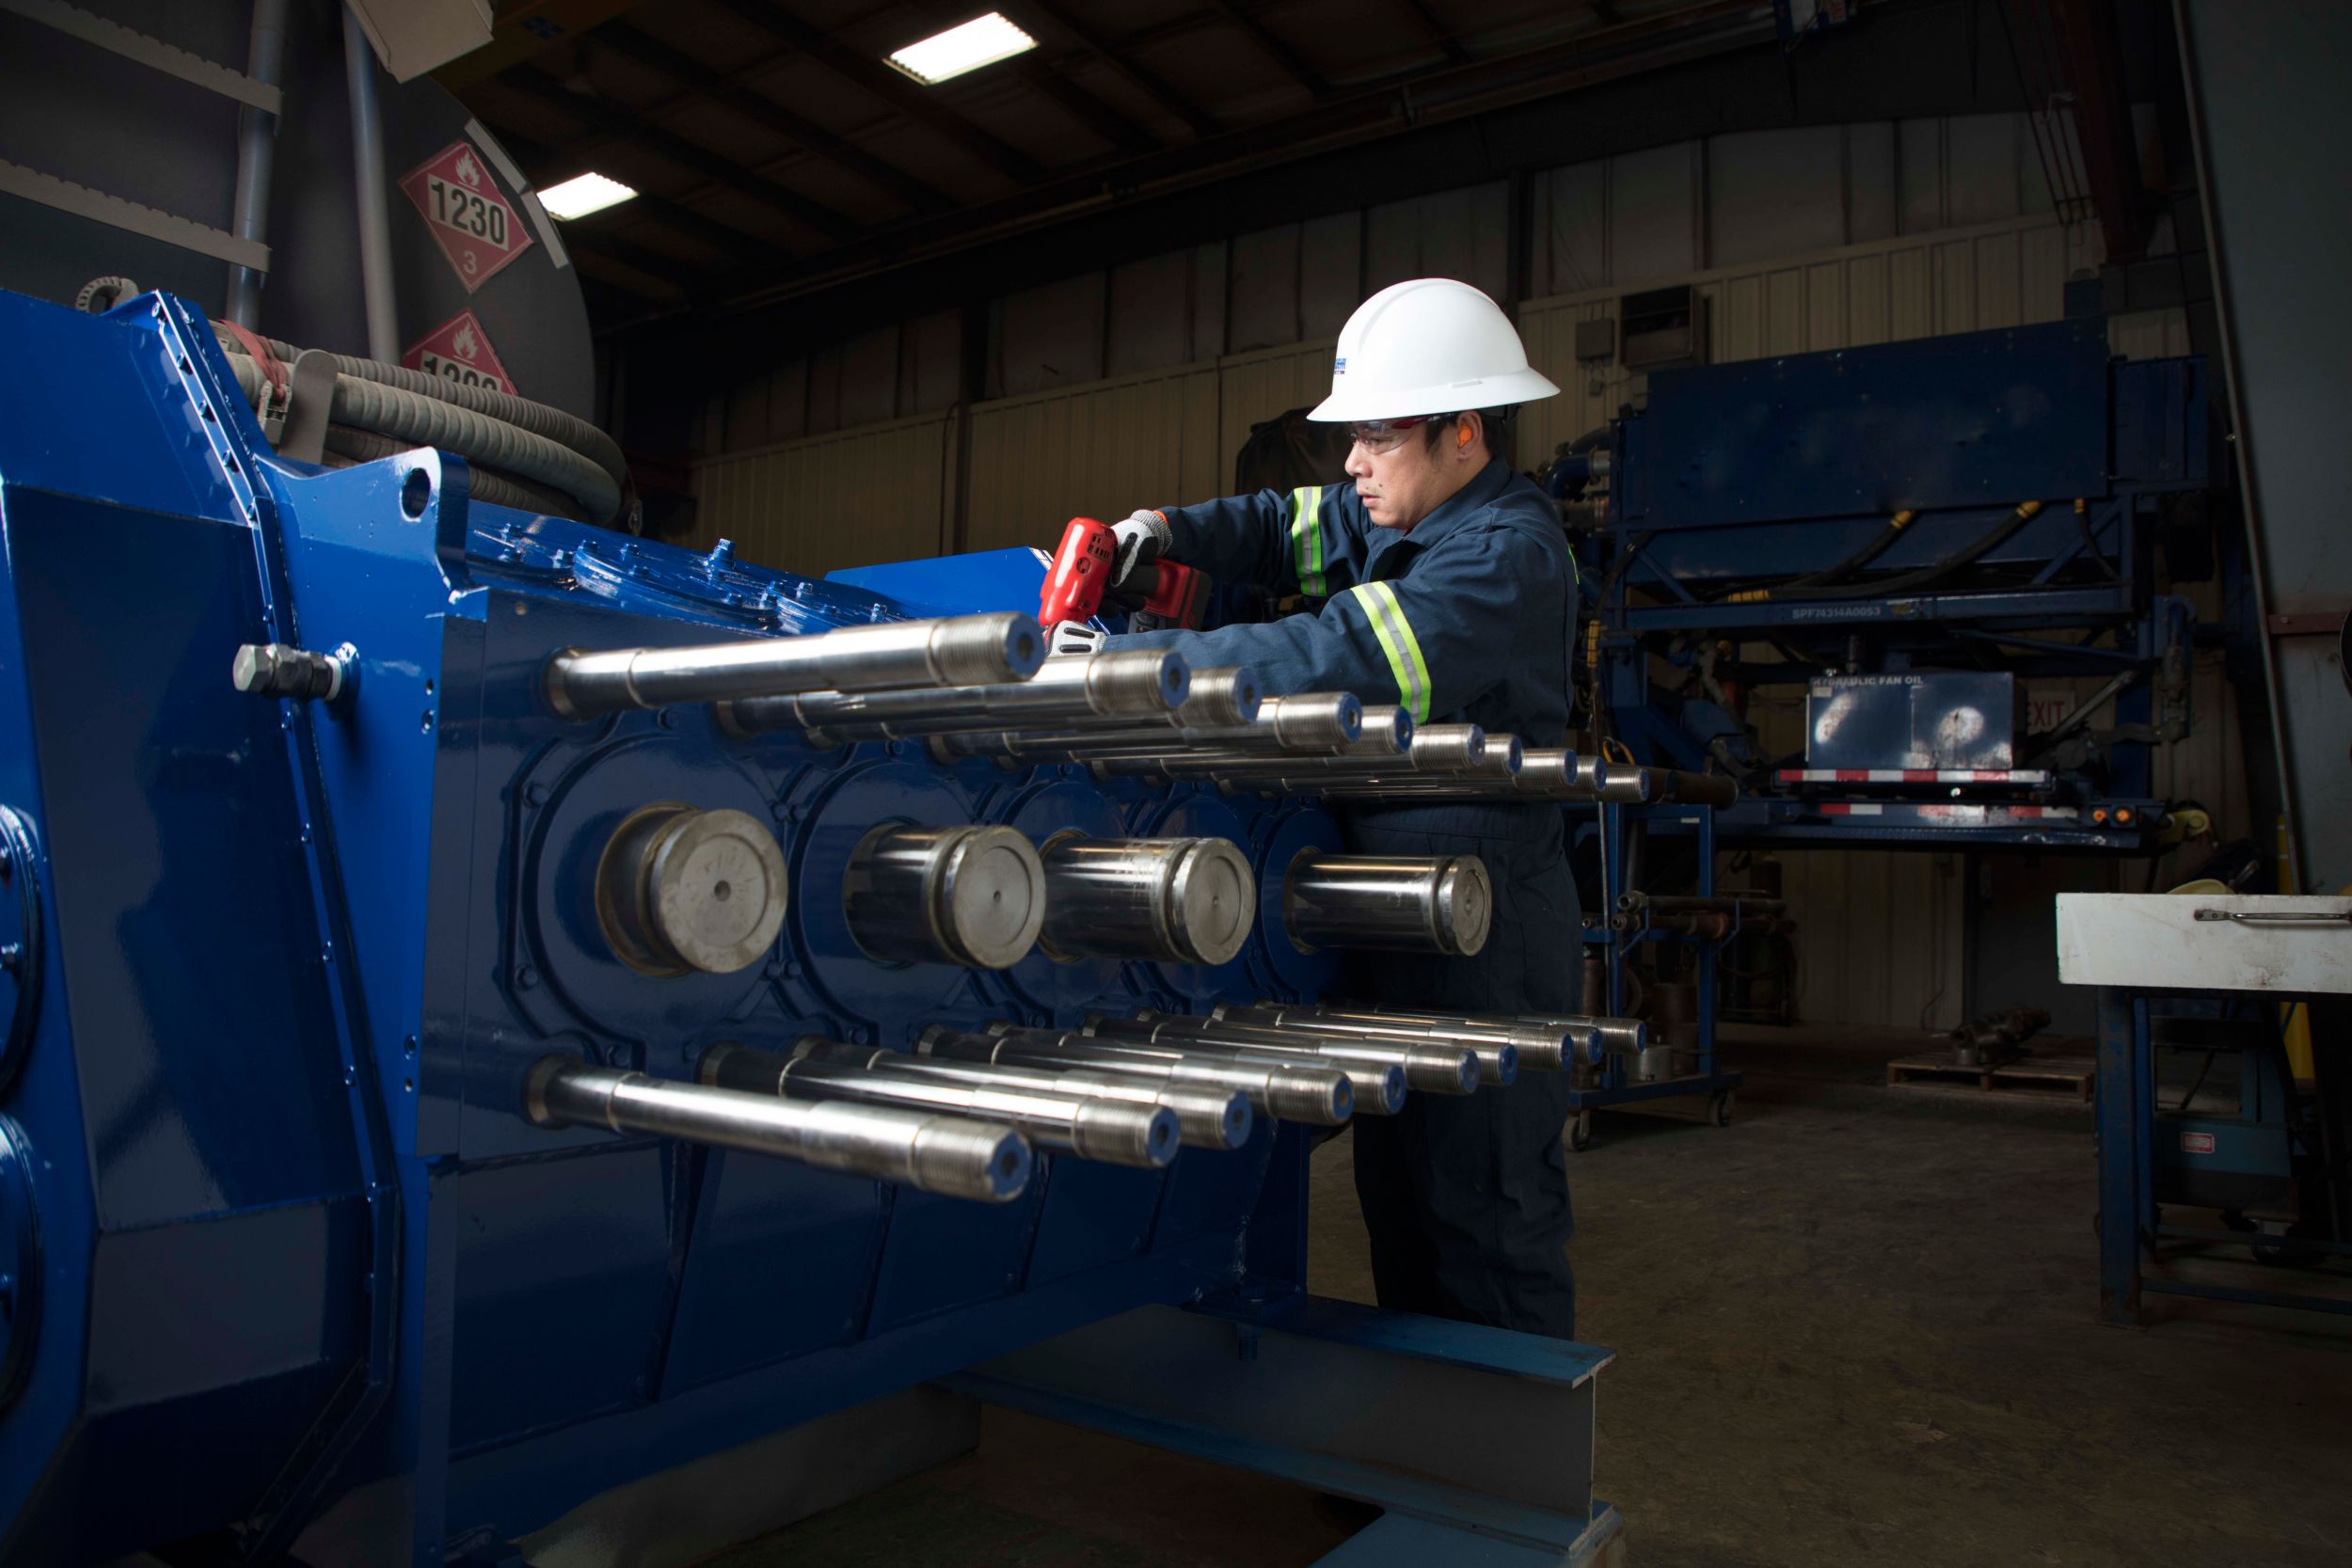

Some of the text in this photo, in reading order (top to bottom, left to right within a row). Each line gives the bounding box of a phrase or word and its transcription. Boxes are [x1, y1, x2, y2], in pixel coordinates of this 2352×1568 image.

[431, 181, 504, 245] 1230
[463, 250, 477, 275] 3
[1879, 676, 1901, 686] FAN
[1904, 674, 1924, 686] OIL
